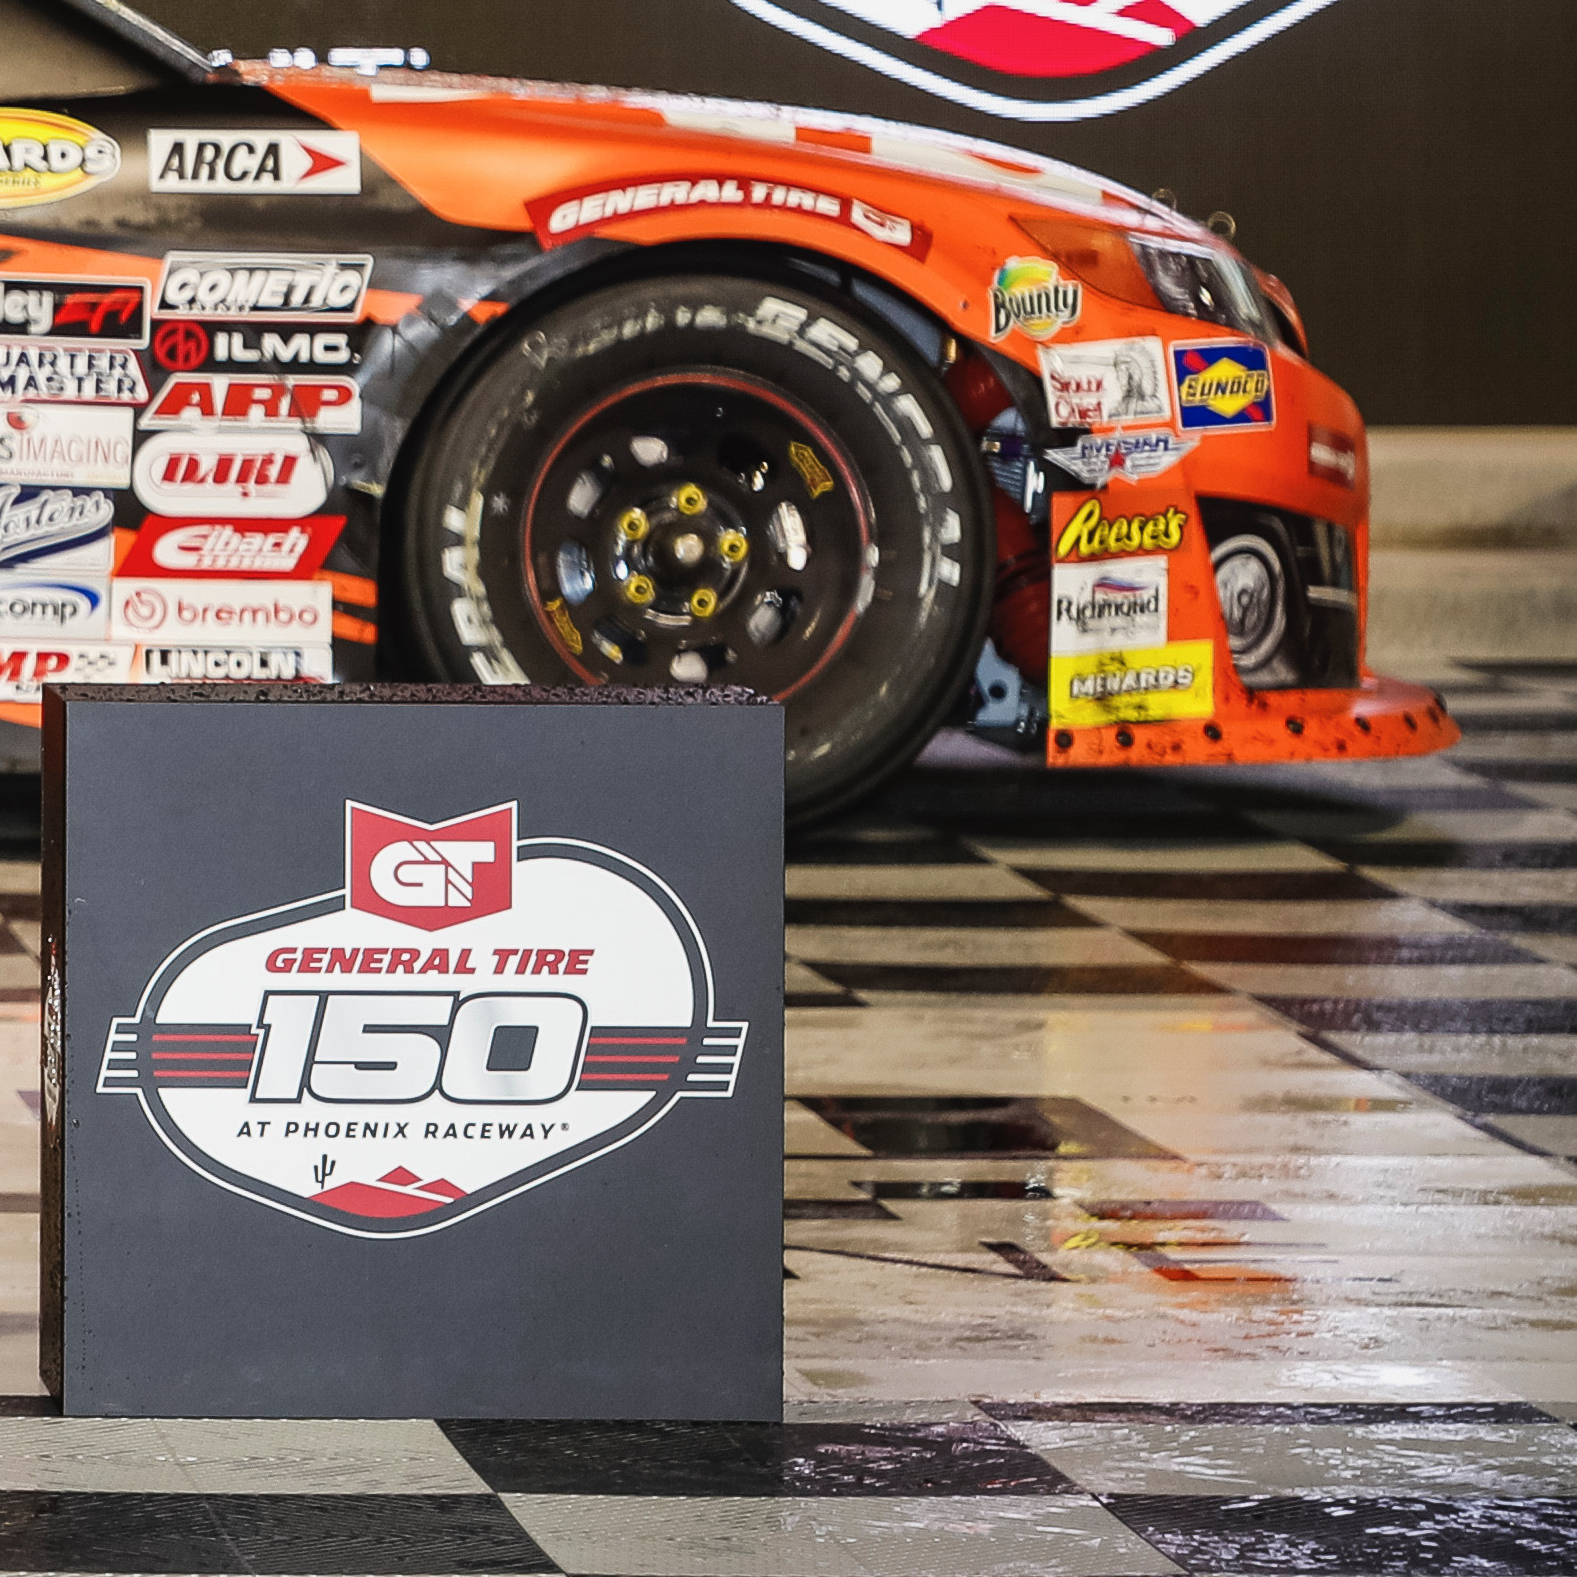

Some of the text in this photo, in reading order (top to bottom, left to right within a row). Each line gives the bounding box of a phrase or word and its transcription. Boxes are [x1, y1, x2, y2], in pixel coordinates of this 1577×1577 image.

[159, 141, 283, 183] ARCA
[548, 179, 842, 235] GENERAL TIRE
[163, 261, 363, 309] COMETIC
[991, 283, 1080, 338] Bounty
[153, 381, 354, 419] ARP
[1182, 371, 1270, 406] SUNOCO
[16, 432, 130, 467] IMAGING
[1056, 498, 1188, 559] Reese's
[152, 524, 311, 573] Eibach
[177, 596, 320, 627] brembo
[1055, 586, 1160, 622] Richmond
[146, 648, 302, 680] LINCOLN
[1069, 663, 1194, 700] MENARDS
[369, 840, 496, 908] GT
[264, 946, 596, 977] GENERAL TIRE
[248, 988, 588, 1105] 150
[236, 1119, 558, 1141] AT PHOENIX RACEWAY
